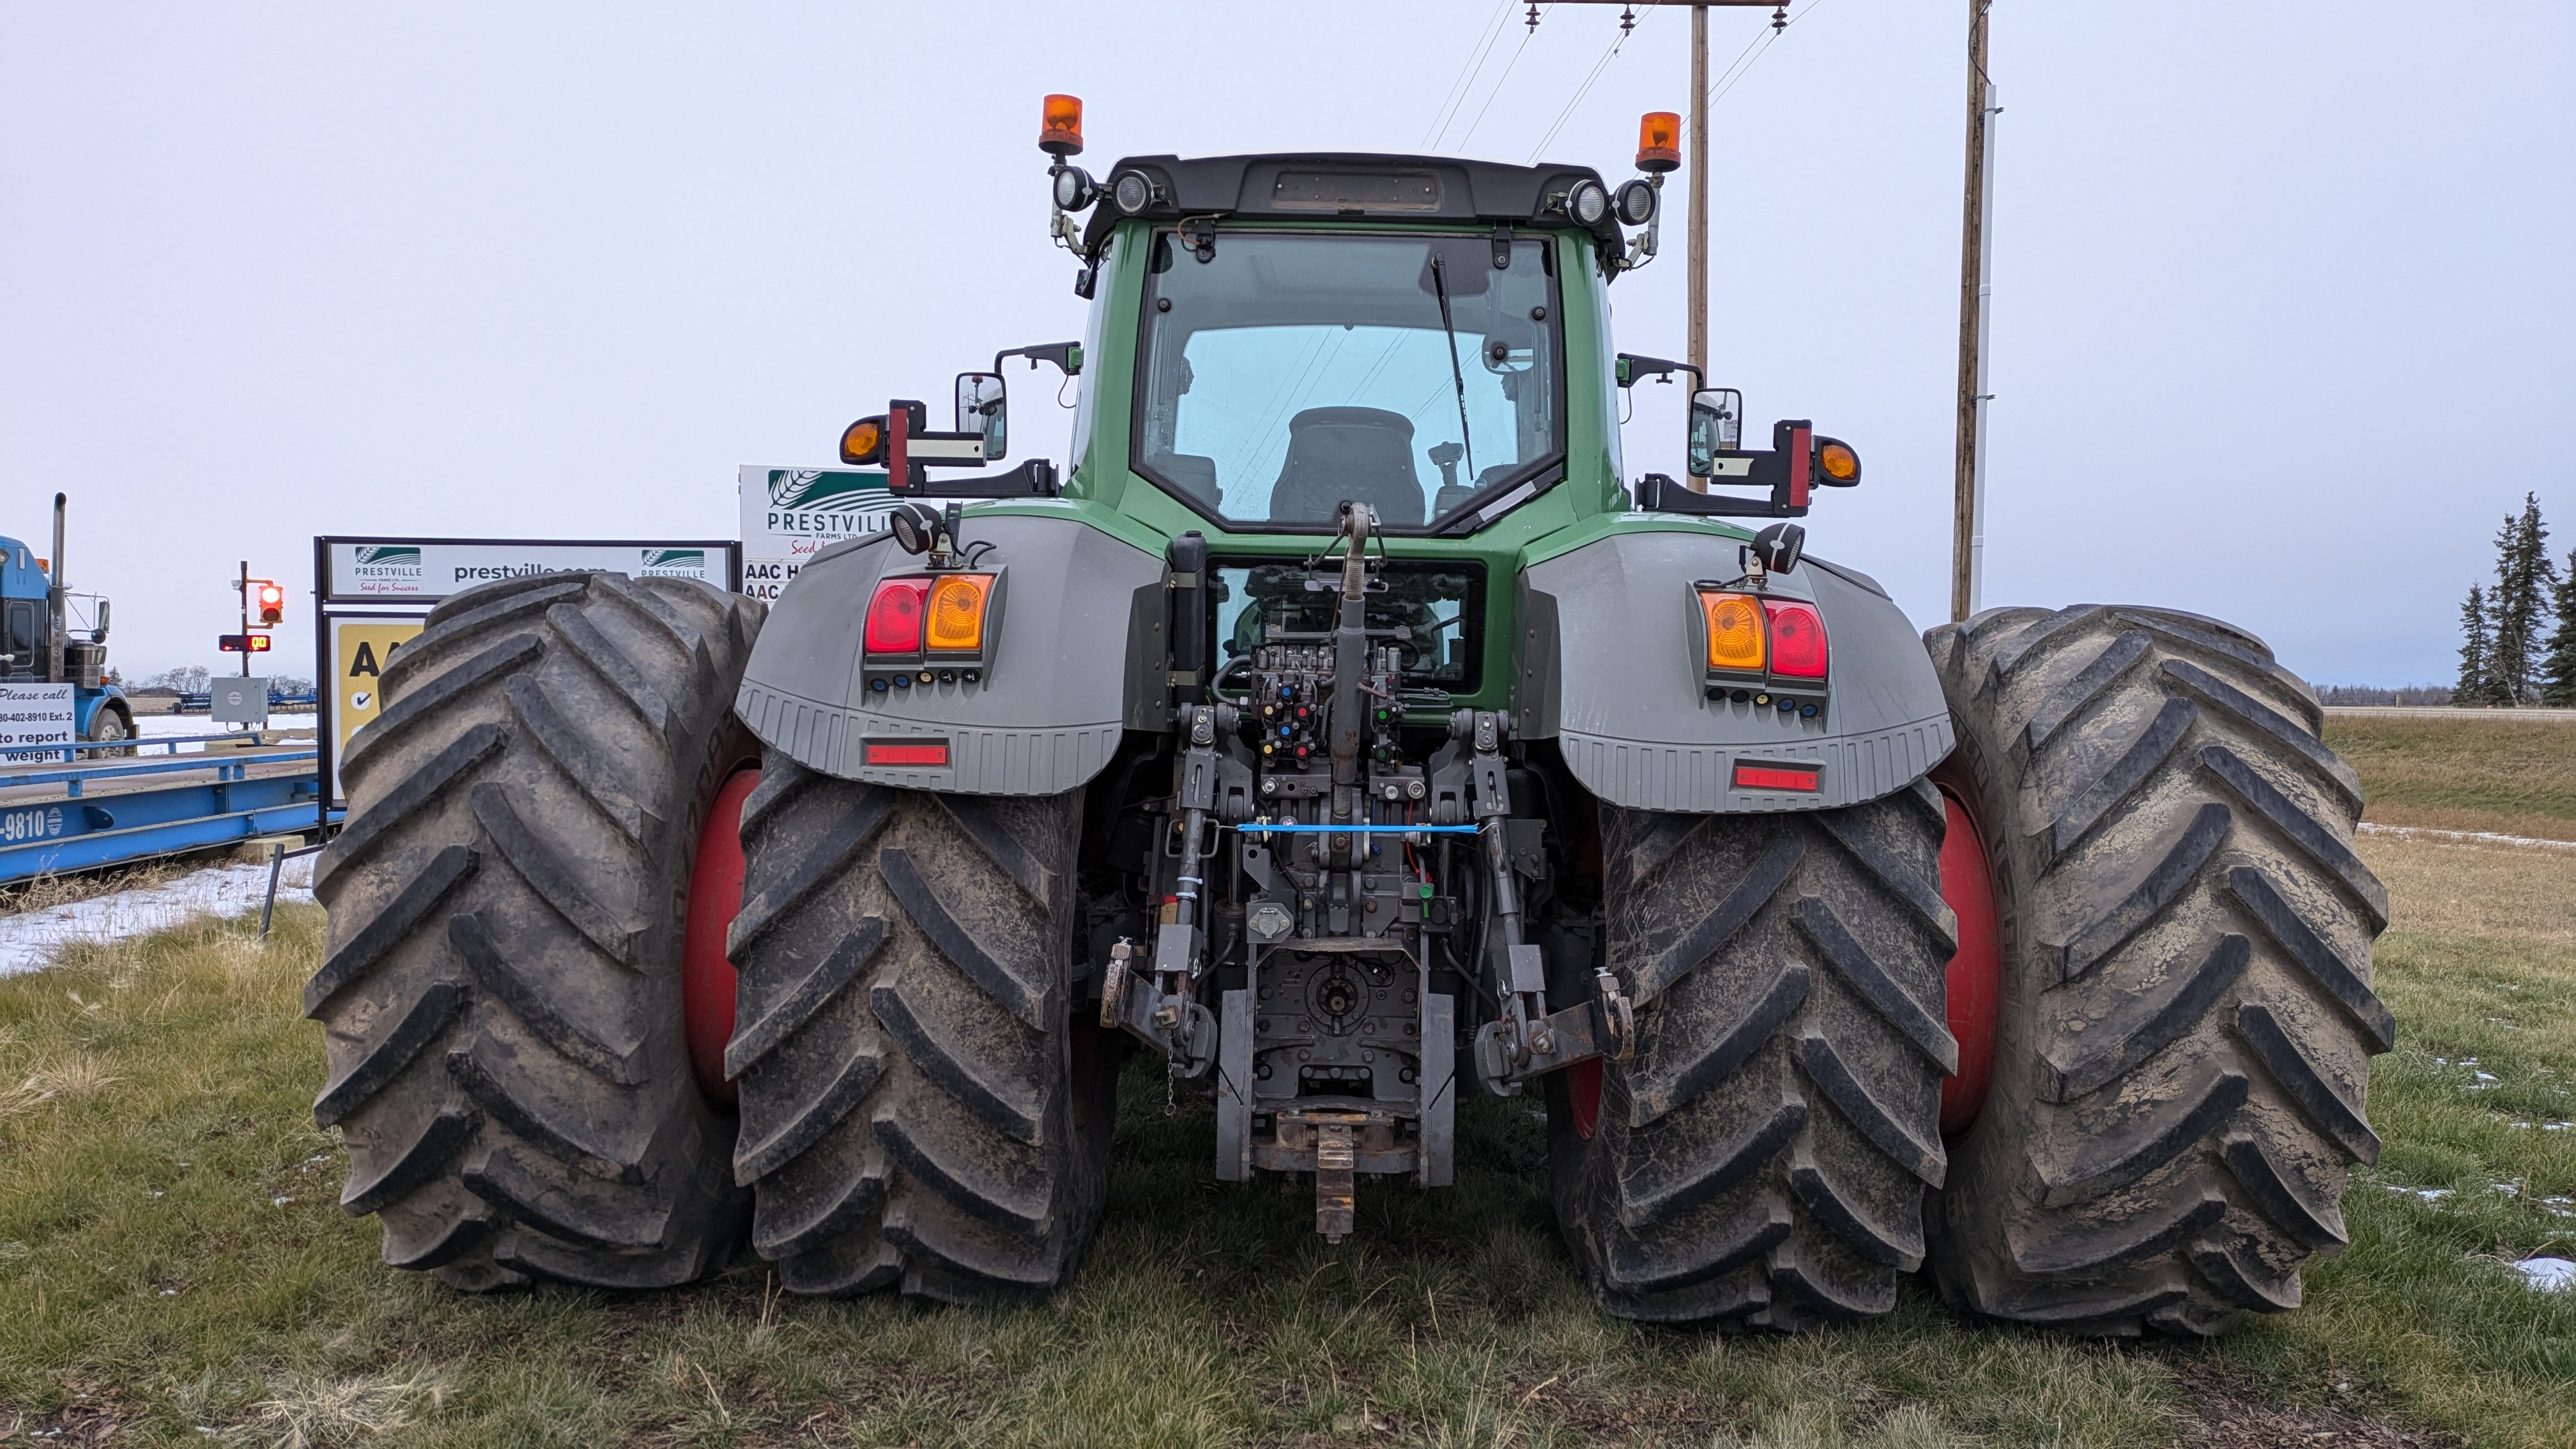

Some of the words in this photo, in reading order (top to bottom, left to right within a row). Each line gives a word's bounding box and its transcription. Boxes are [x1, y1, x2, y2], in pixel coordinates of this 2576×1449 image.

[768, 512, 885, 533] PRESTVILL
[791, 539, 817, 555] Seed
[355, 567, 422, 576] PRESTVILLE
[641, 570, 705, 578] PRESTVILLE
[745, 564, 781, 579] AAC
[360, 582, 376, 592] Seed
[378, 583, 389, 594] for
[392, 582, 418, 592] Success
[746, 585, 779, 600] AAC
[0, 688, 40, 700] Please
[42, 689, 68, 700] call
[49, 712, 65, 721] Ext.
[66, 712, 73, 721] 2
[0, 732, 13, 744] to
[19, 731, 68, 745] report
[6, 751, 60, 763] weight
